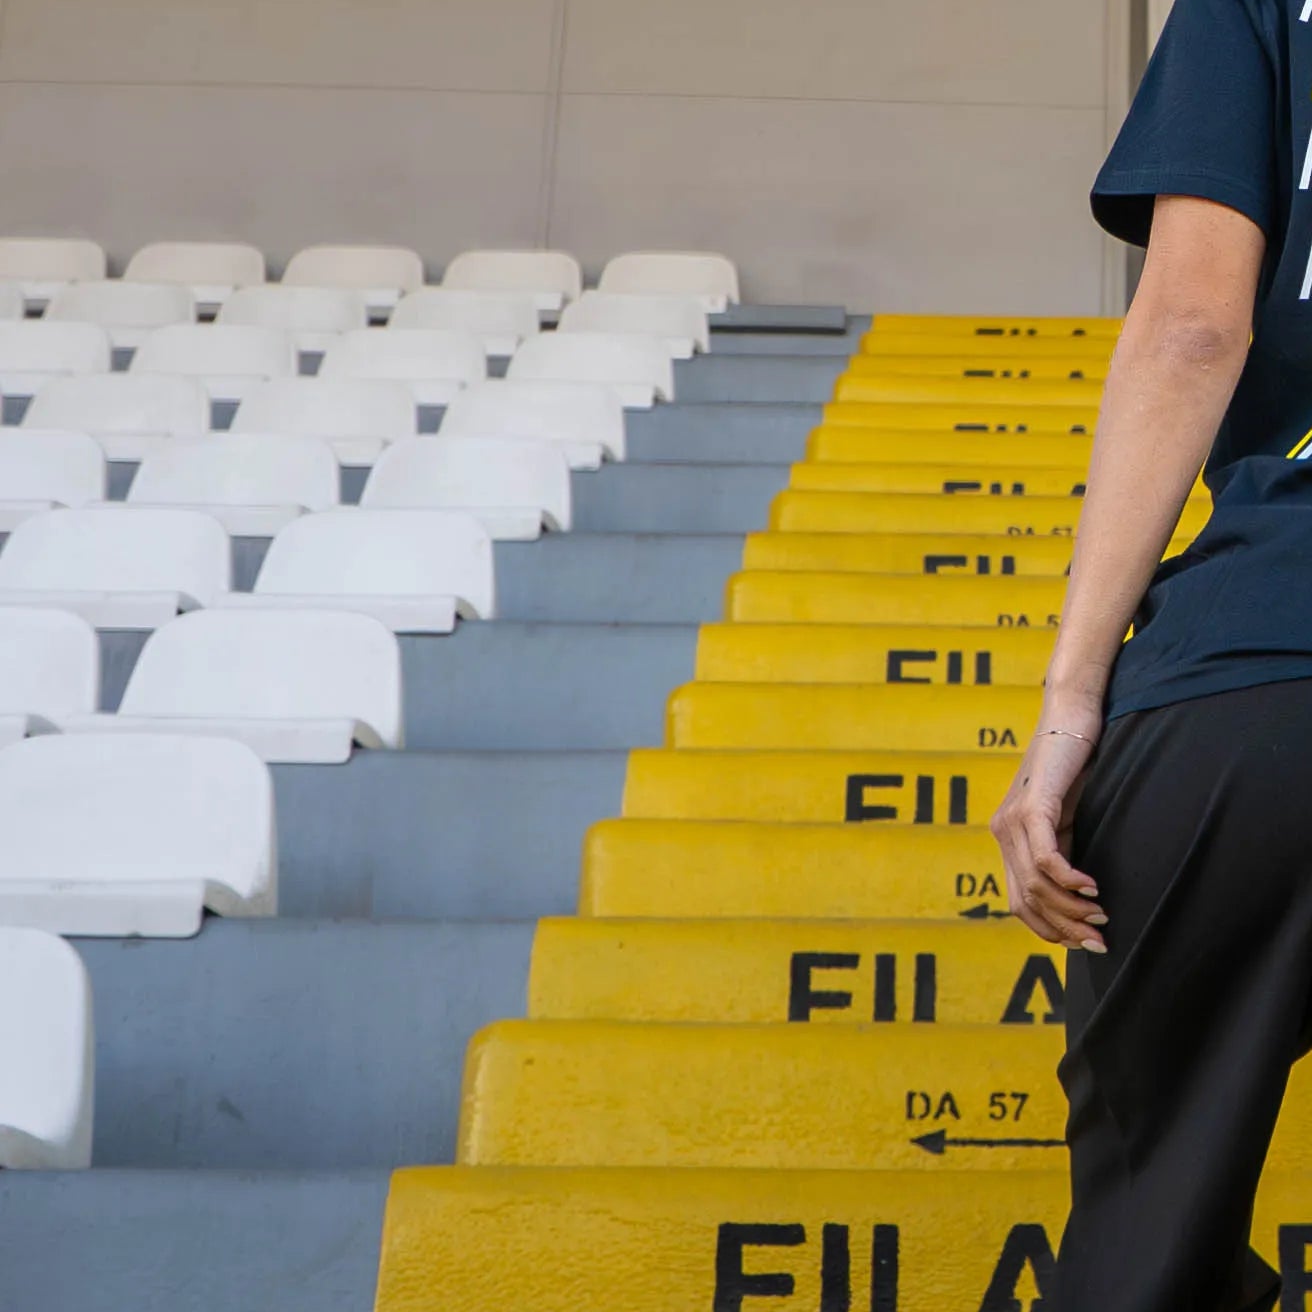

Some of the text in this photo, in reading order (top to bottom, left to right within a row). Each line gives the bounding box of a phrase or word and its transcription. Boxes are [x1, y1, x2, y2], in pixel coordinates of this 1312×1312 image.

[978, 728, 1018, 748] DA
[956, 873, 1001, 897] DA
[905, 1091, 1029, 1120] DA 57
